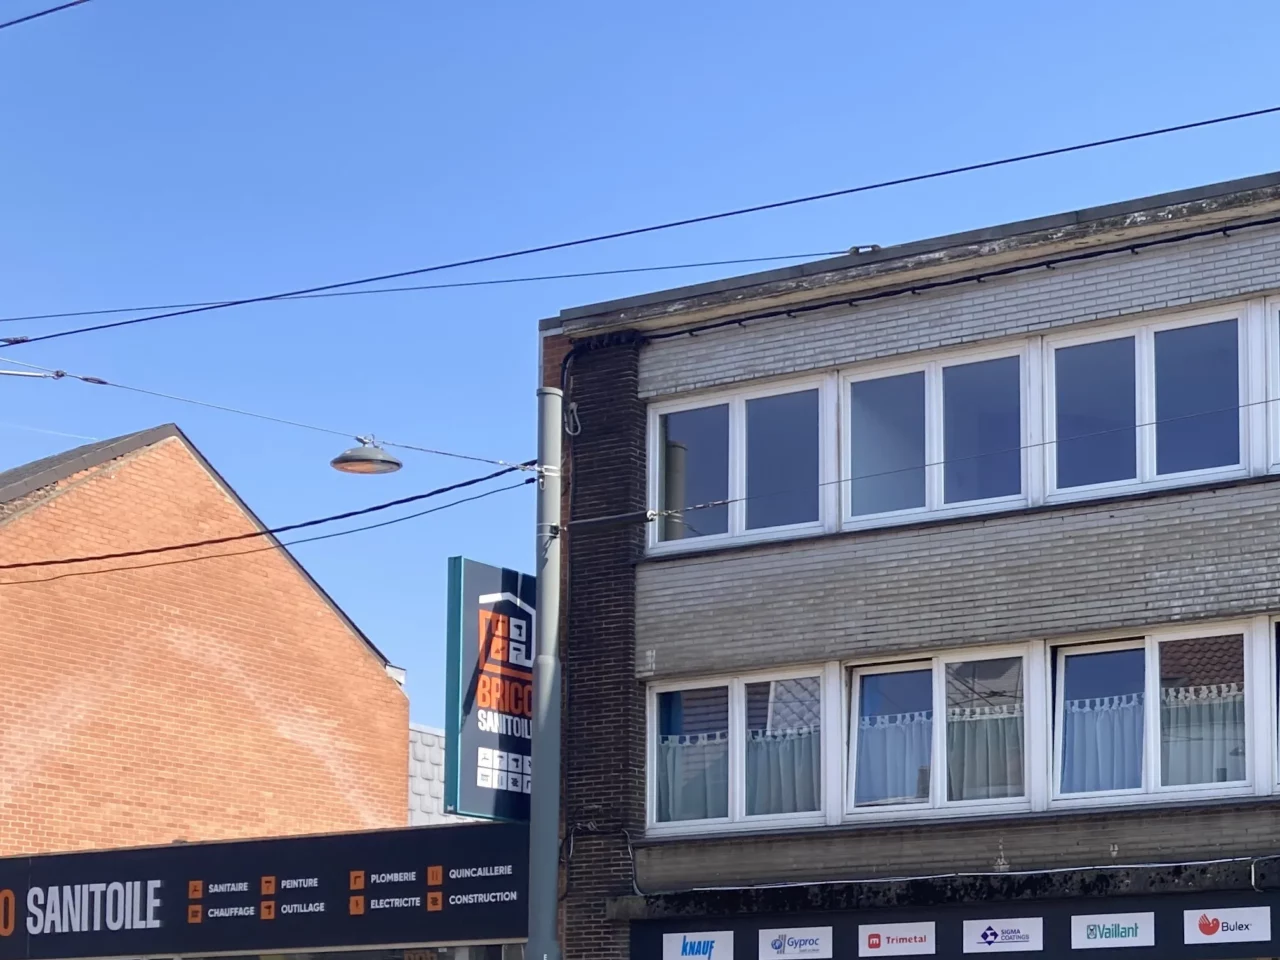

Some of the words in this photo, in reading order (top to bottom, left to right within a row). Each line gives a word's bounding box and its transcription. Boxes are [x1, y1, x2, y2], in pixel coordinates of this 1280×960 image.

[477, 709, 532, 739] SANITOIL
[371, 871, 416, 884] PLOMBERIE
[449, 865, 512, 879] QUINCAILLERIE
[208, 882, 249, 893] SANITAIRE
[281, 878, 318, 889] PEINTURE
[371, 897, 421, 909] ELECTRICITE
[449, 891, 517, 905] CONSTRUCTION
[26, 879, 162, 935] SANITOILE
[208, 906, 255, 918] CHAUFFAGE
[281, 903, 325, 914] OUTILLAGE
[1097, 923, 1139, 939] Vaillant
[1221, 921, 1250, 932] Bulex
[786, 936, 820, 949] Gyproc
[885, 934, 927, 945] Trimetal
